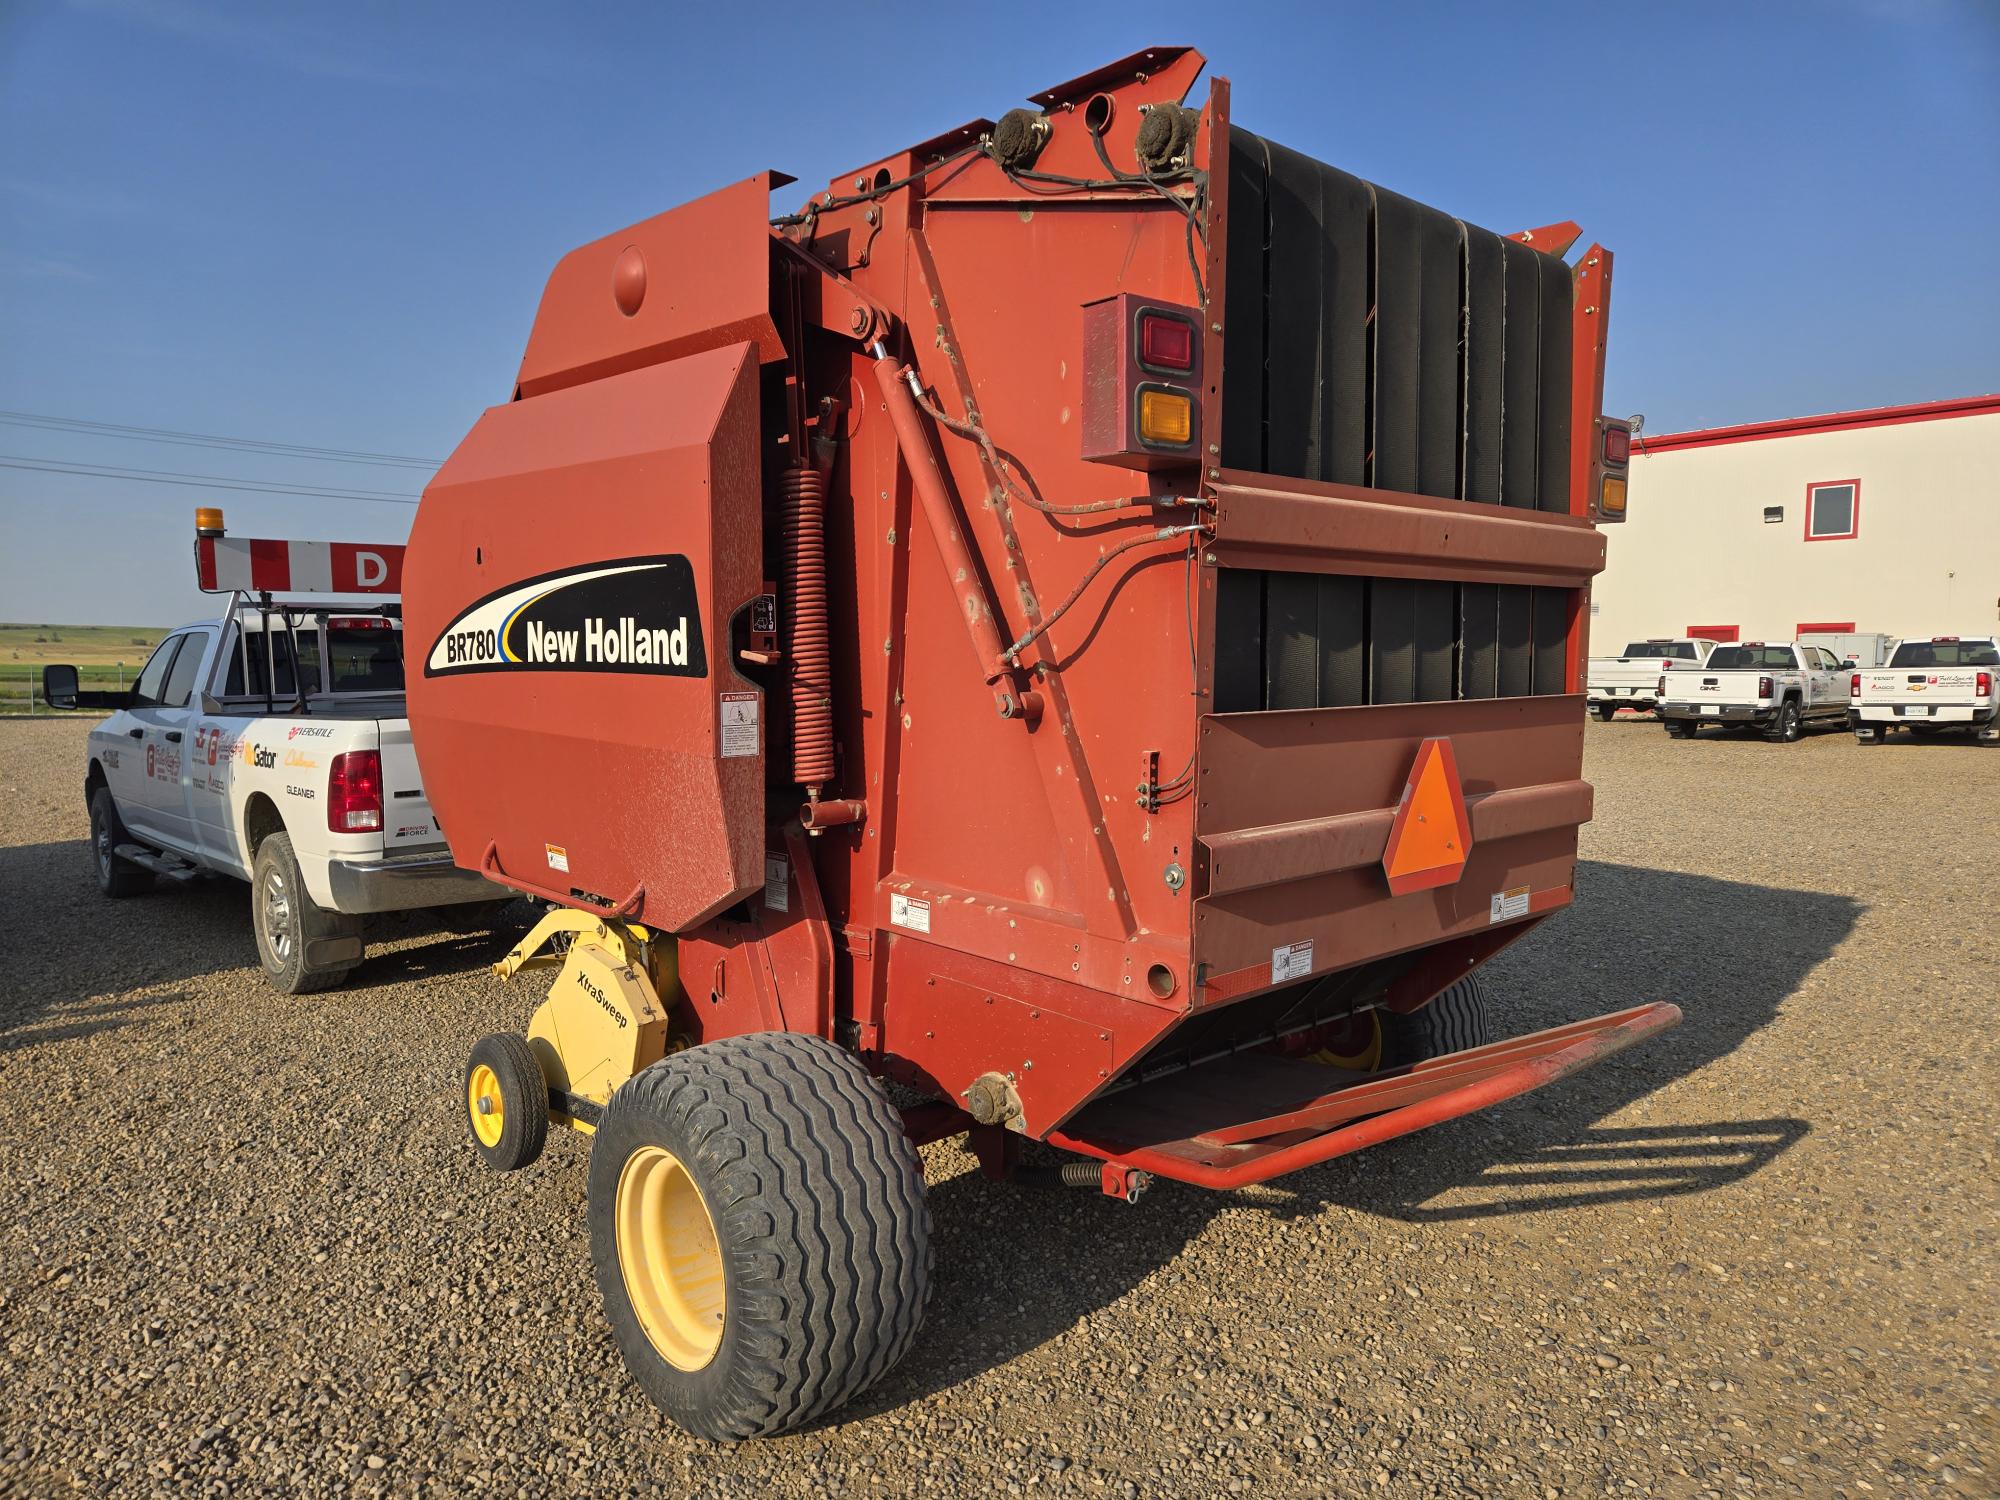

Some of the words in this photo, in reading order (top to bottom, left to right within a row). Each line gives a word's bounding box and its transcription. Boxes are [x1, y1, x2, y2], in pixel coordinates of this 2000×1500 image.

[356, 551, 387, 587] D
[447, 629, 496, 664] BR780
[527, 620, 578, 663] New
[585, 616, 688, 666] Holland
[286, 784, 316, 800] GLEANER
[405, 829, 429, 837] FORCE
[577, 970, 628, 1028] XtraSweep
